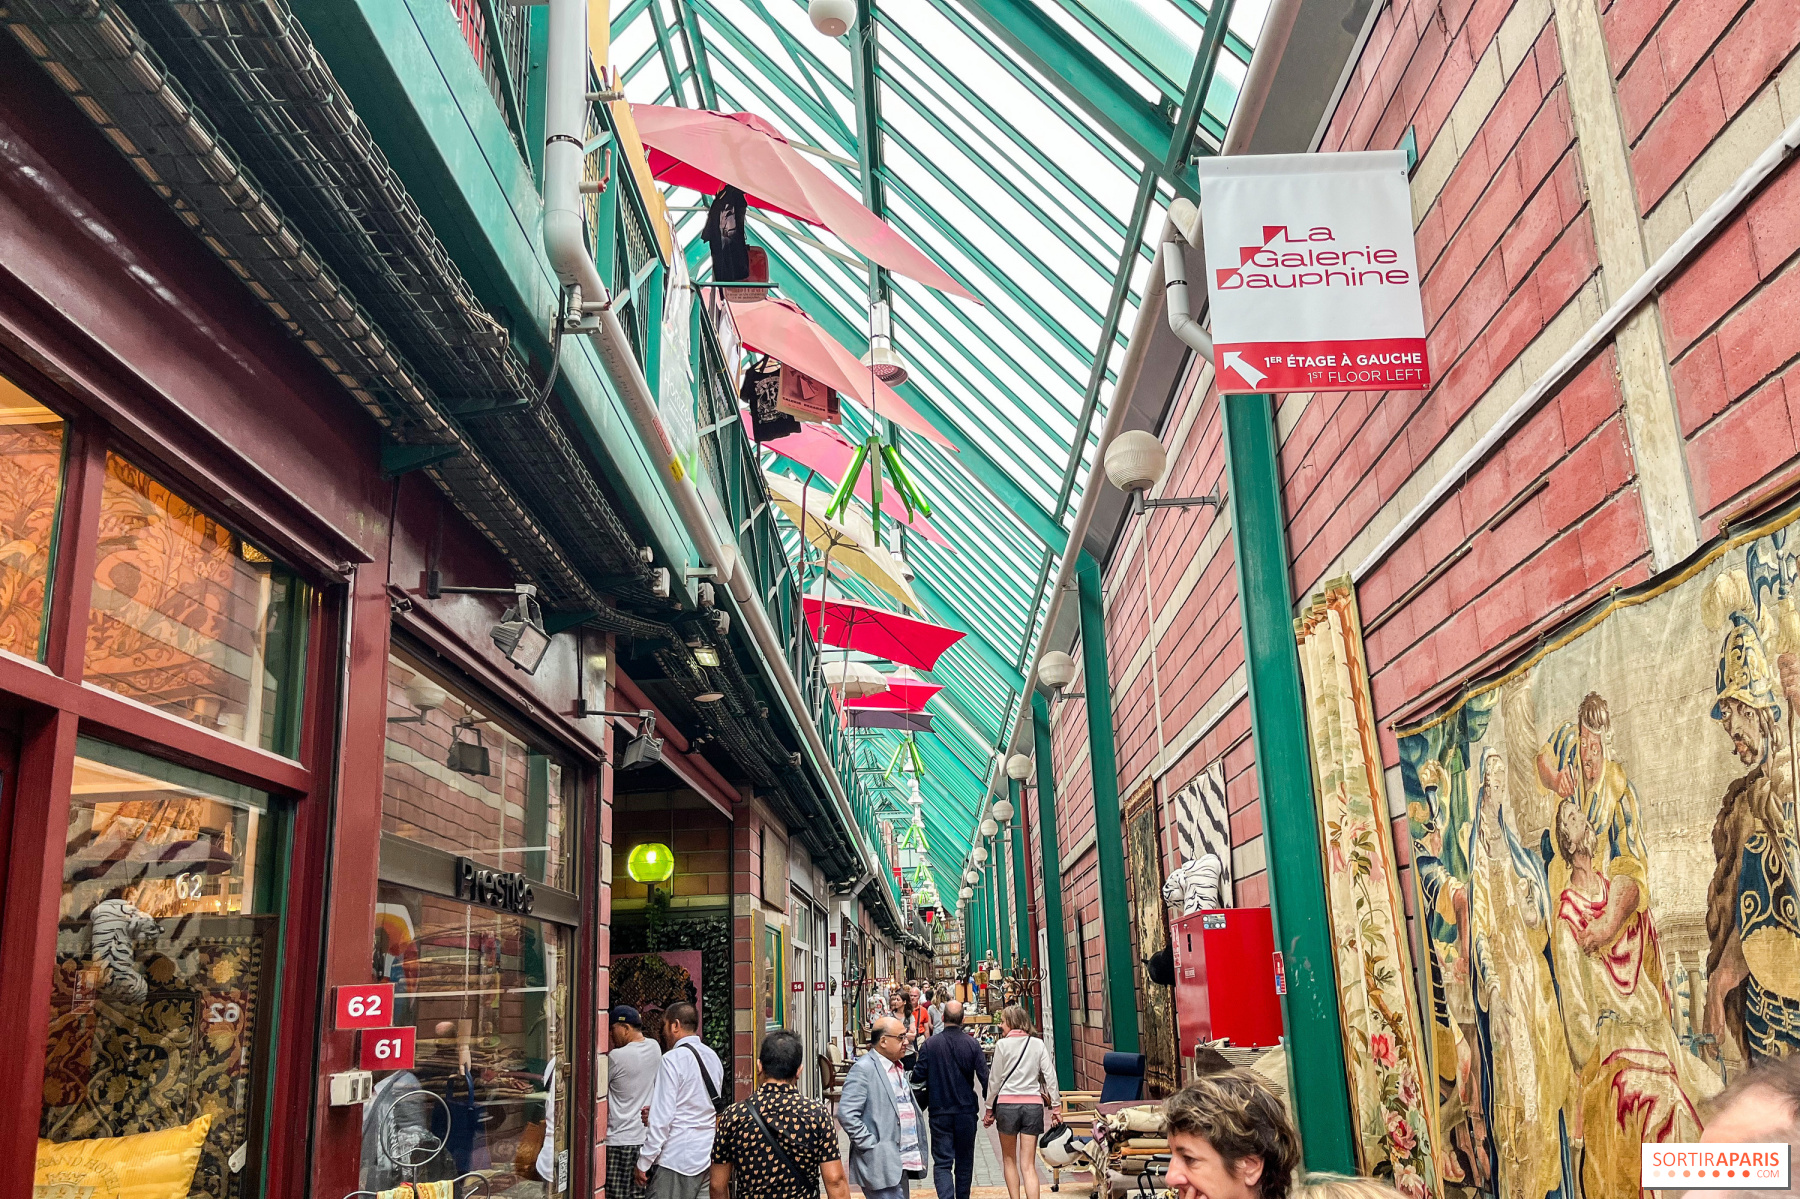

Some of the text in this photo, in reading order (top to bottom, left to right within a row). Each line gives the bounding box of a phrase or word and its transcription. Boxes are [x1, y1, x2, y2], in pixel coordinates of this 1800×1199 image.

[1284, 226, 1336, 243] La
[1250, 246, 1398, 268] Galerie
[1217, 267, 1410, 290] Dauphine
[1264, 353, 1423, 368] 1ER ÉTAGE À GAUCHE
[1307, 368, 1423, 383] 1ST FLOOR LEFT
[176, 872, 203, 900] 62
[456, 856, 534, 914] Prestige
[348, 995, 382, 1017] 62
[375, 1038, 402, 1059] 61
[36, 1156, 83, 1171] RAND
